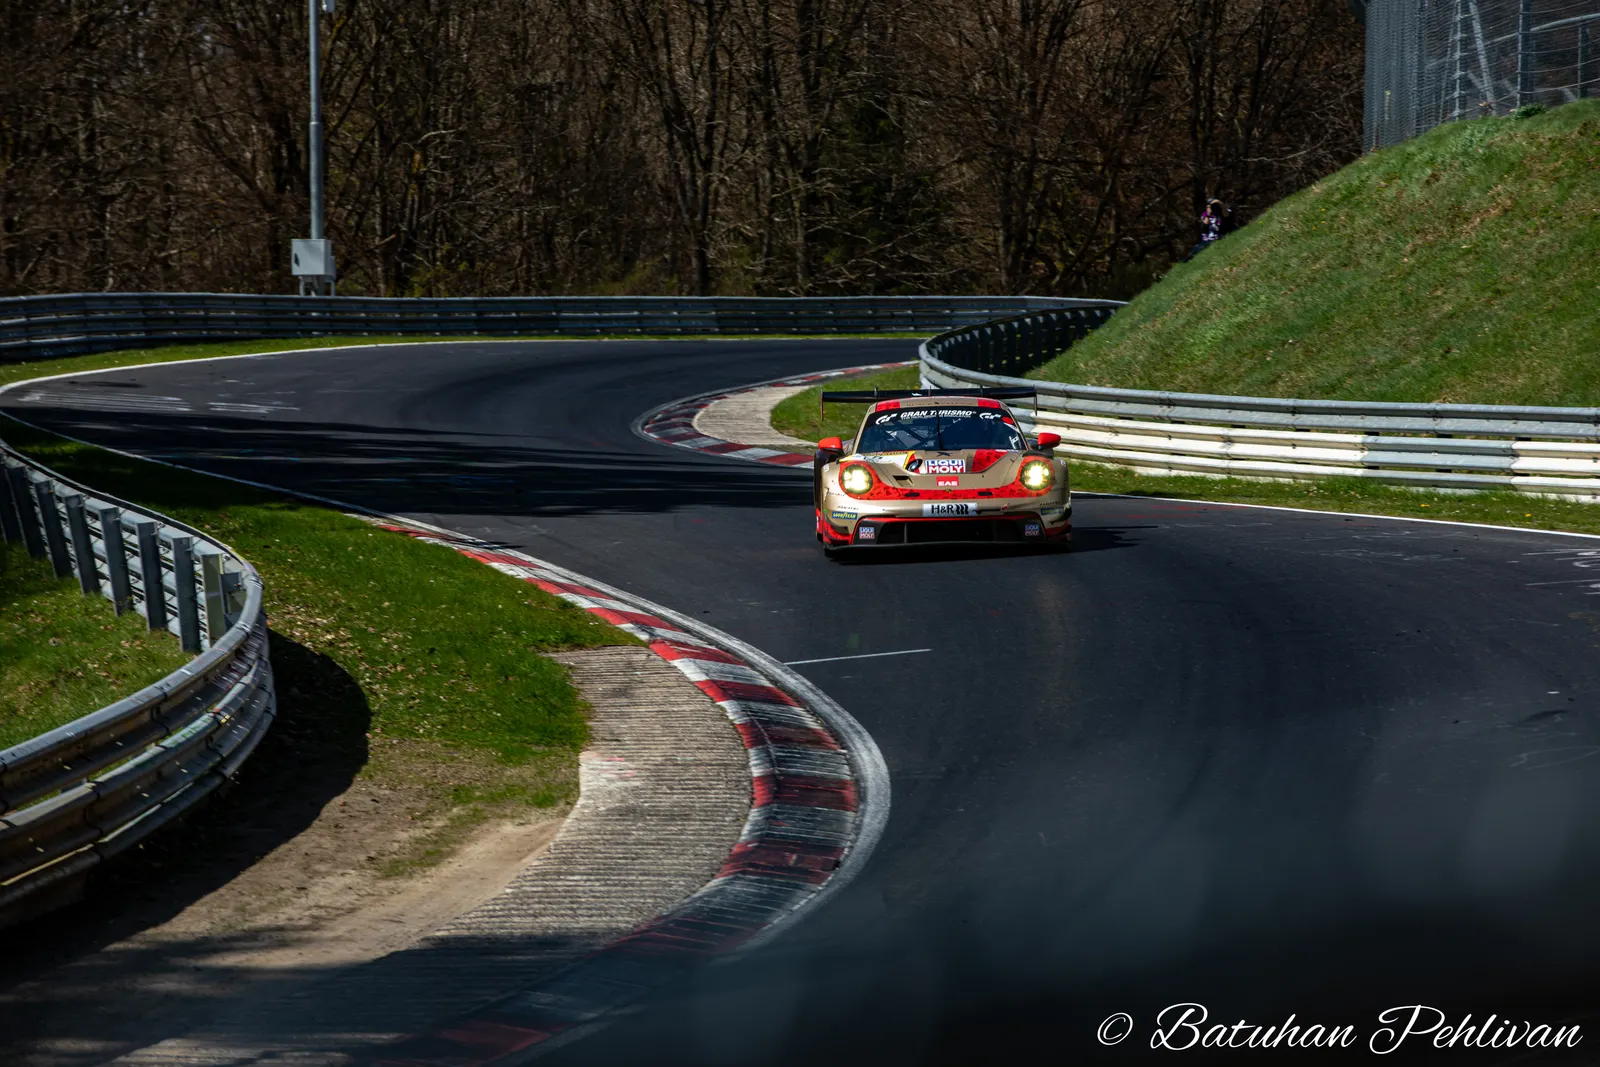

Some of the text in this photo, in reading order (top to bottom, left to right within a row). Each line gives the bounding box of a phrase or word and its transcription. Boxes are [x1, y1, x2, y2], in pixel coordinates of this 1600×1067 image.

[900, 410, 928, 418] GRAN
[928, 465, 964, 473] MOLY
[931, 504, 954, 514] H&R
